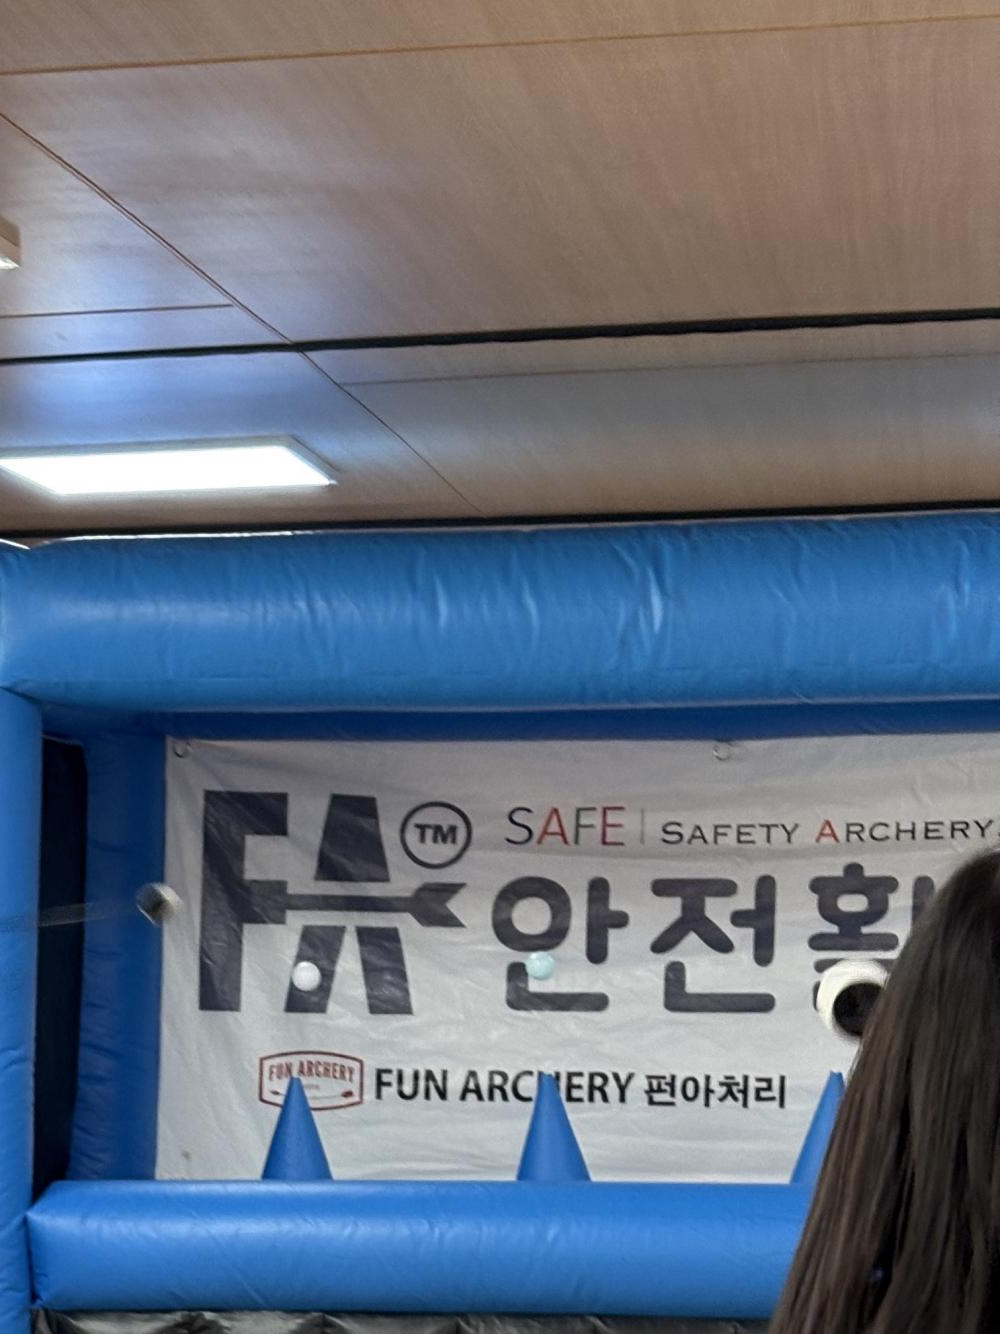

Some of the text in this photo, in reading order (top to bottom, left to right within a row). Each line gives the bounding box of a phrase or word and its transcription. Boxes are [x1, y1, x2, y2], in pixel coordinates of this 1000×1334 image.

[505, 807, 994, 846] SAFE SAFETY ARCHERY
[375, 1068, 448, 1100] FUN
